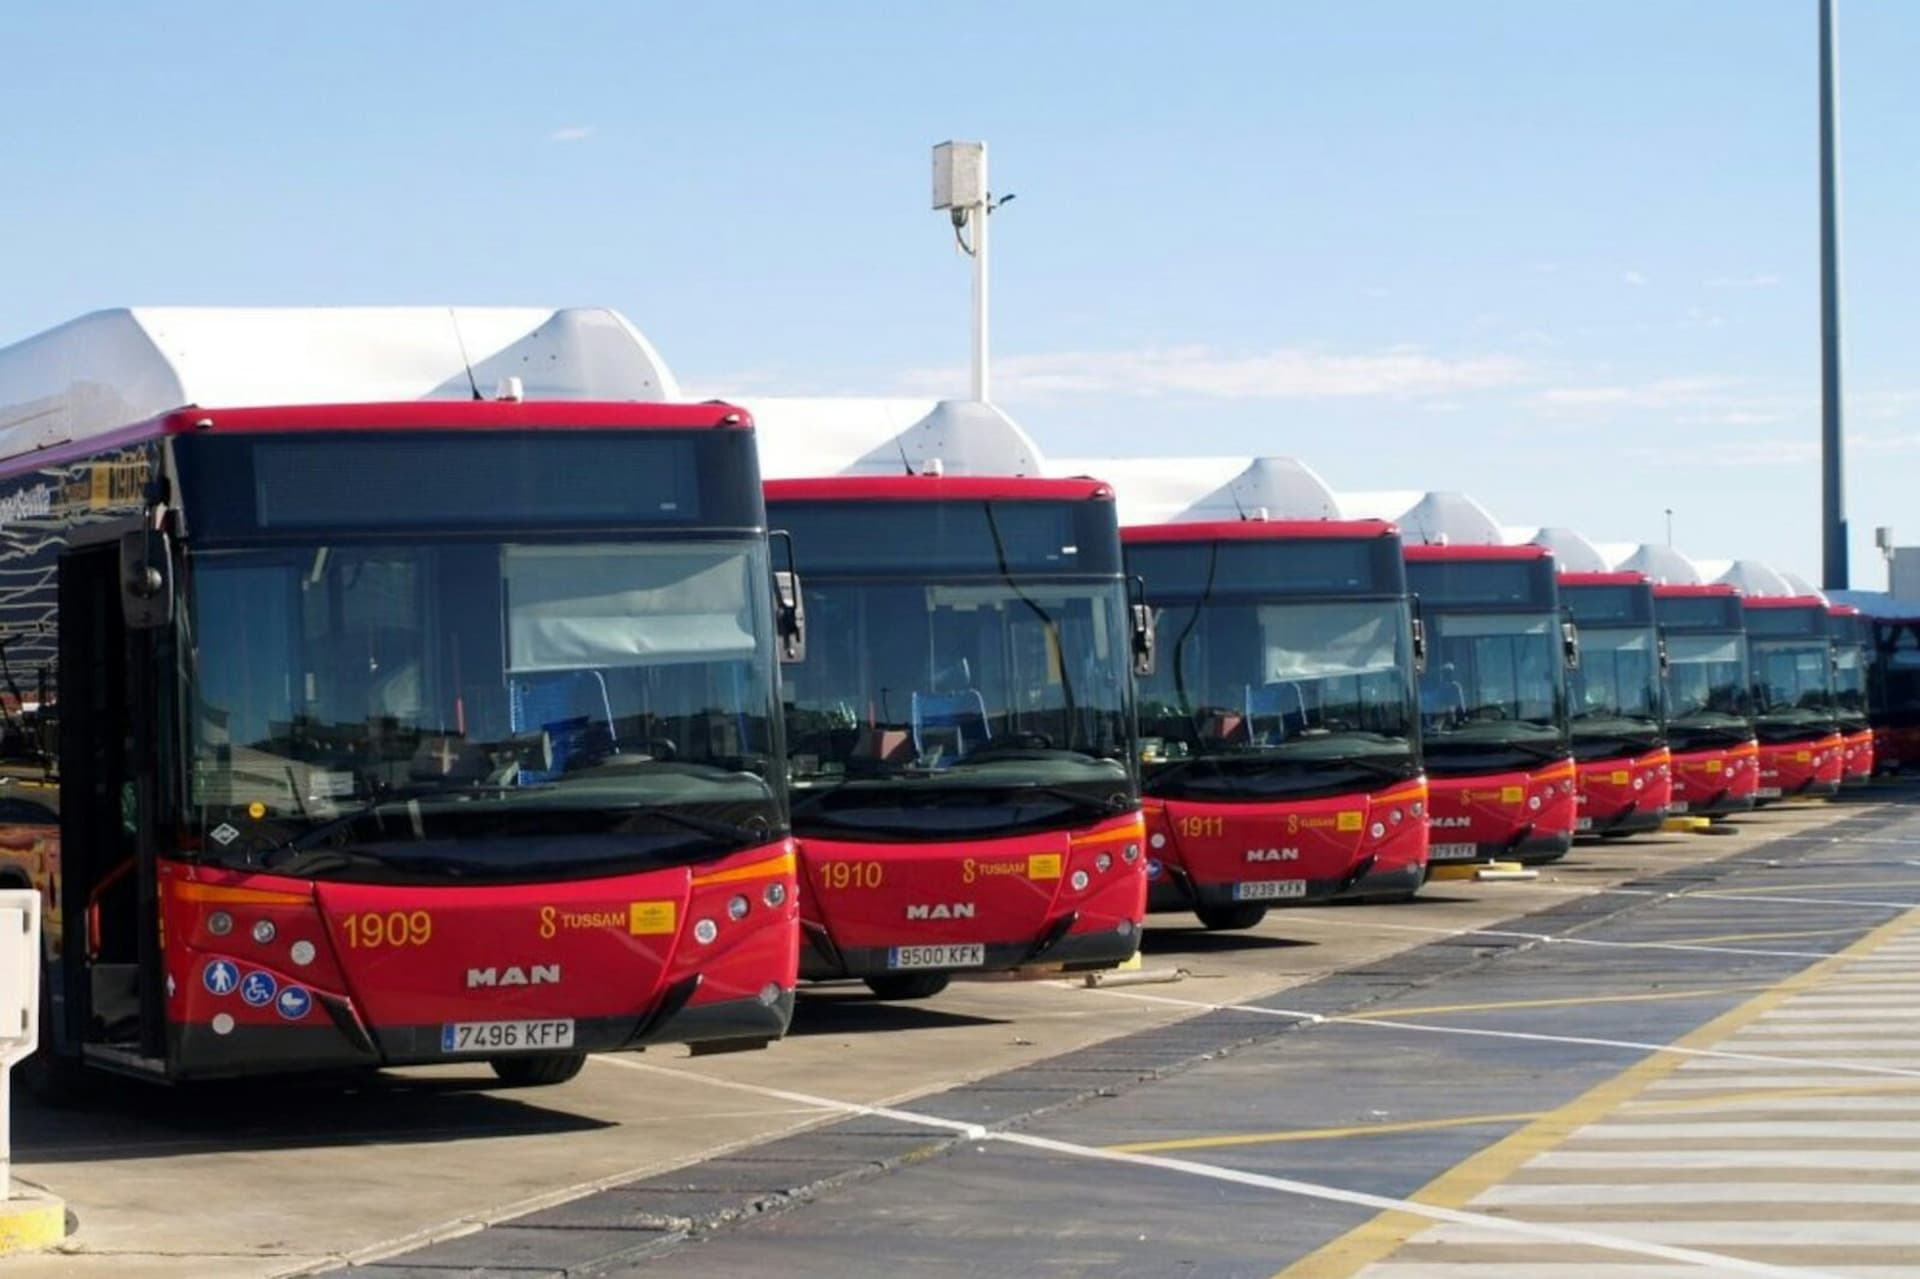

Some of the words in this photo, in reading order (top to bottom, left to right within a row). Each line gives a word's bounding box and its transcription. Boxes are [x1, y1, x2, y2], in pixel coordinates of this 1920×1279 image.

[1179, 816, 1223, 837] 1911
[1428, 816, 1471, 828] MAN
[1247, 848, 1299, 861] MAN
[820, 861, 882, 888] 1910
[979, 863, 1026, 876] TUSSAM
[562, 913, 626, 929] TUSSAM
[906, 903, 976, 920] MAN
[343, 911, 432, 948] 1909
[901, 947, 943, 965] 9500
[949, 946, 980, 962] KFK
[467, 965, 561, 988] MAN
[460, 1024, 518, 1047] 7496
[525, 1023, 569, 1045] KFP
